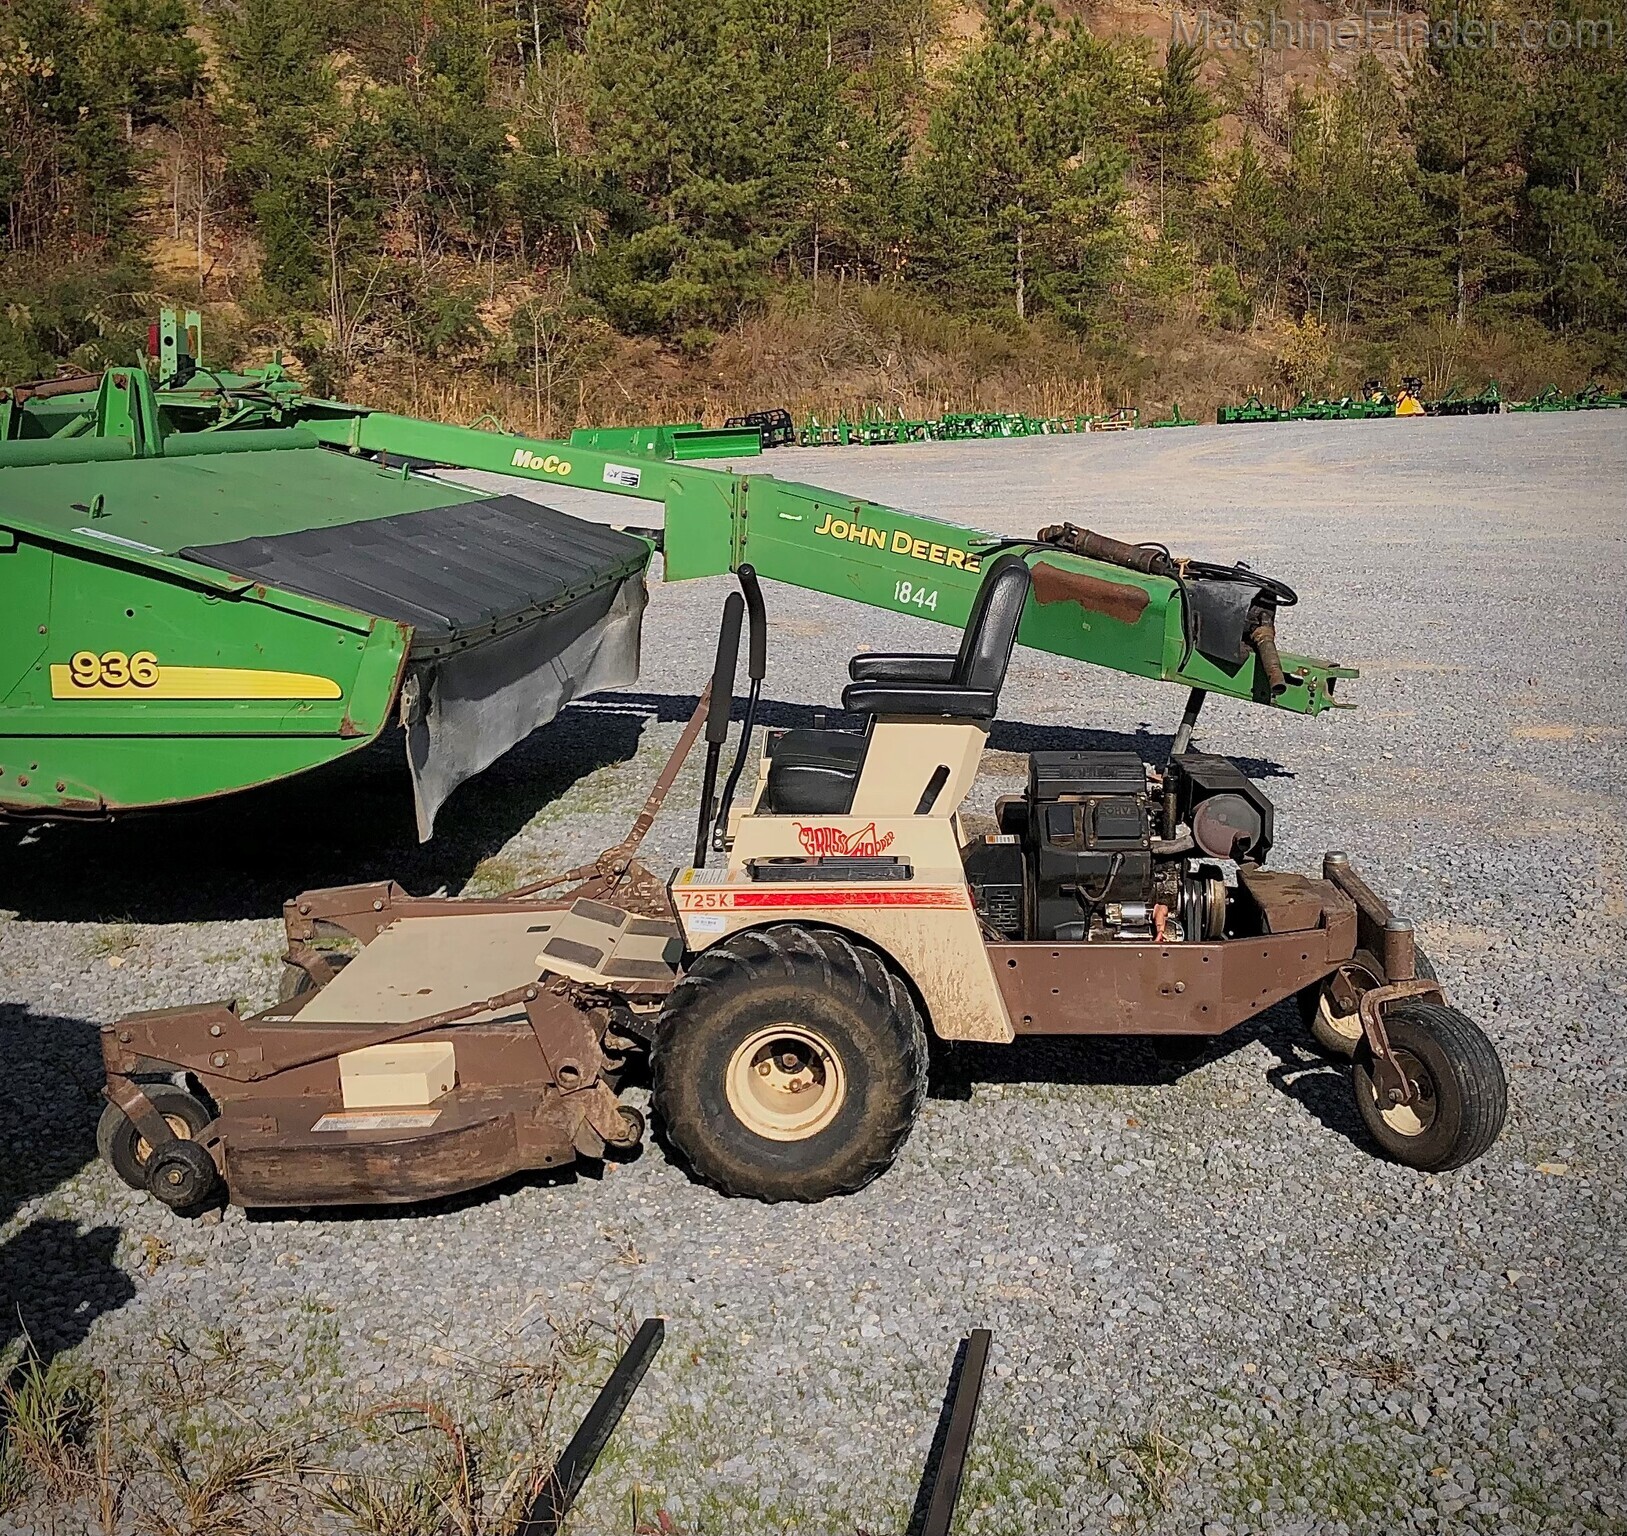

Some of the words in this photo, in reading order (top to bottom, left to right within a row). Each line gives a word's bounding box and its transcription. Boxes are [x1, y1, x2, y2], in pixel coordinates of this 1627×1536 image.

[511, 448, 572, 476] MoCo
[814, 513, 887, 549] JOHN
[890, 529, 984, 574] DEERE
[894, 580, 938, 611] 1844
[70, 651, 159, 687] 936
[681, 893, 729, 908] 725K
